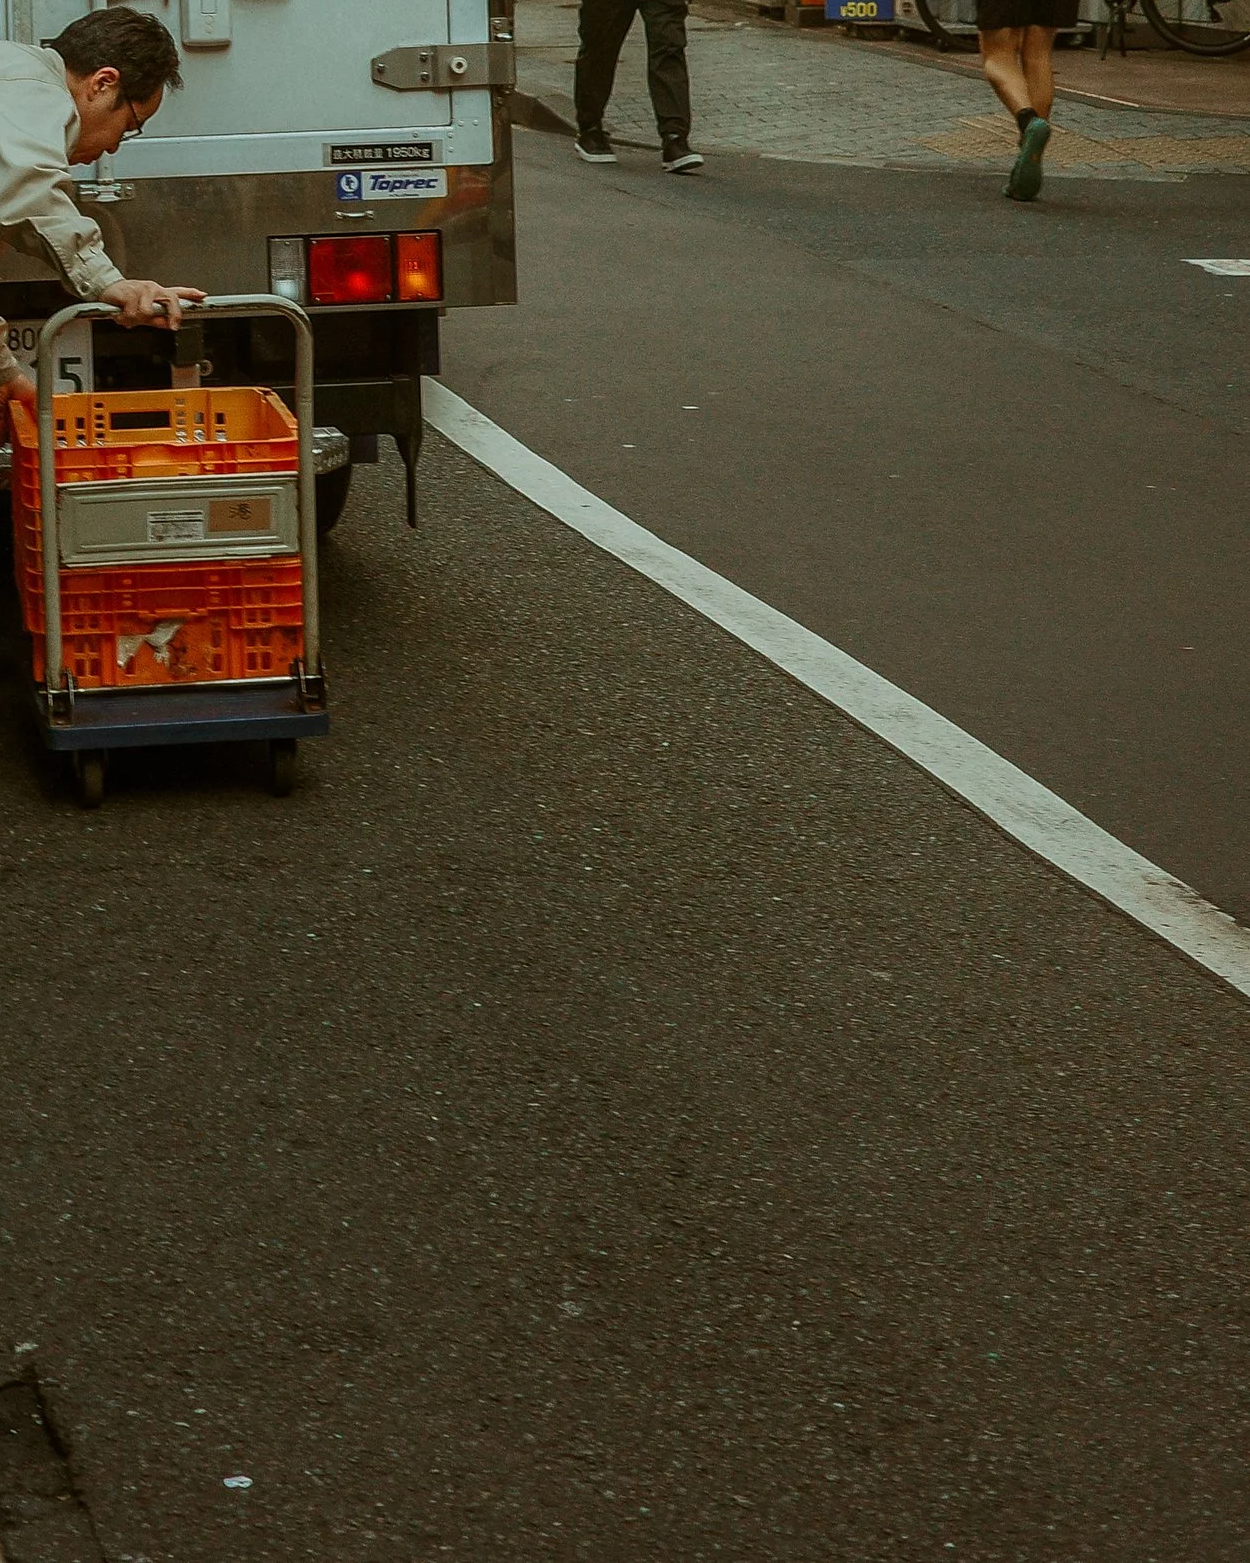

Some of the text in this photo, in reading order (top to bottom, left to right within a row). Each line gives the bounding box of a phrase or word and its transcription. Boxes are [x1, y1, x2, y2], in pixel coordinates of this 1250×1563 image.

[840, 2, 878, 18] ¥500
[386, 146, 430, 159] 1950kg
[8, 327, 41, 351] 80
